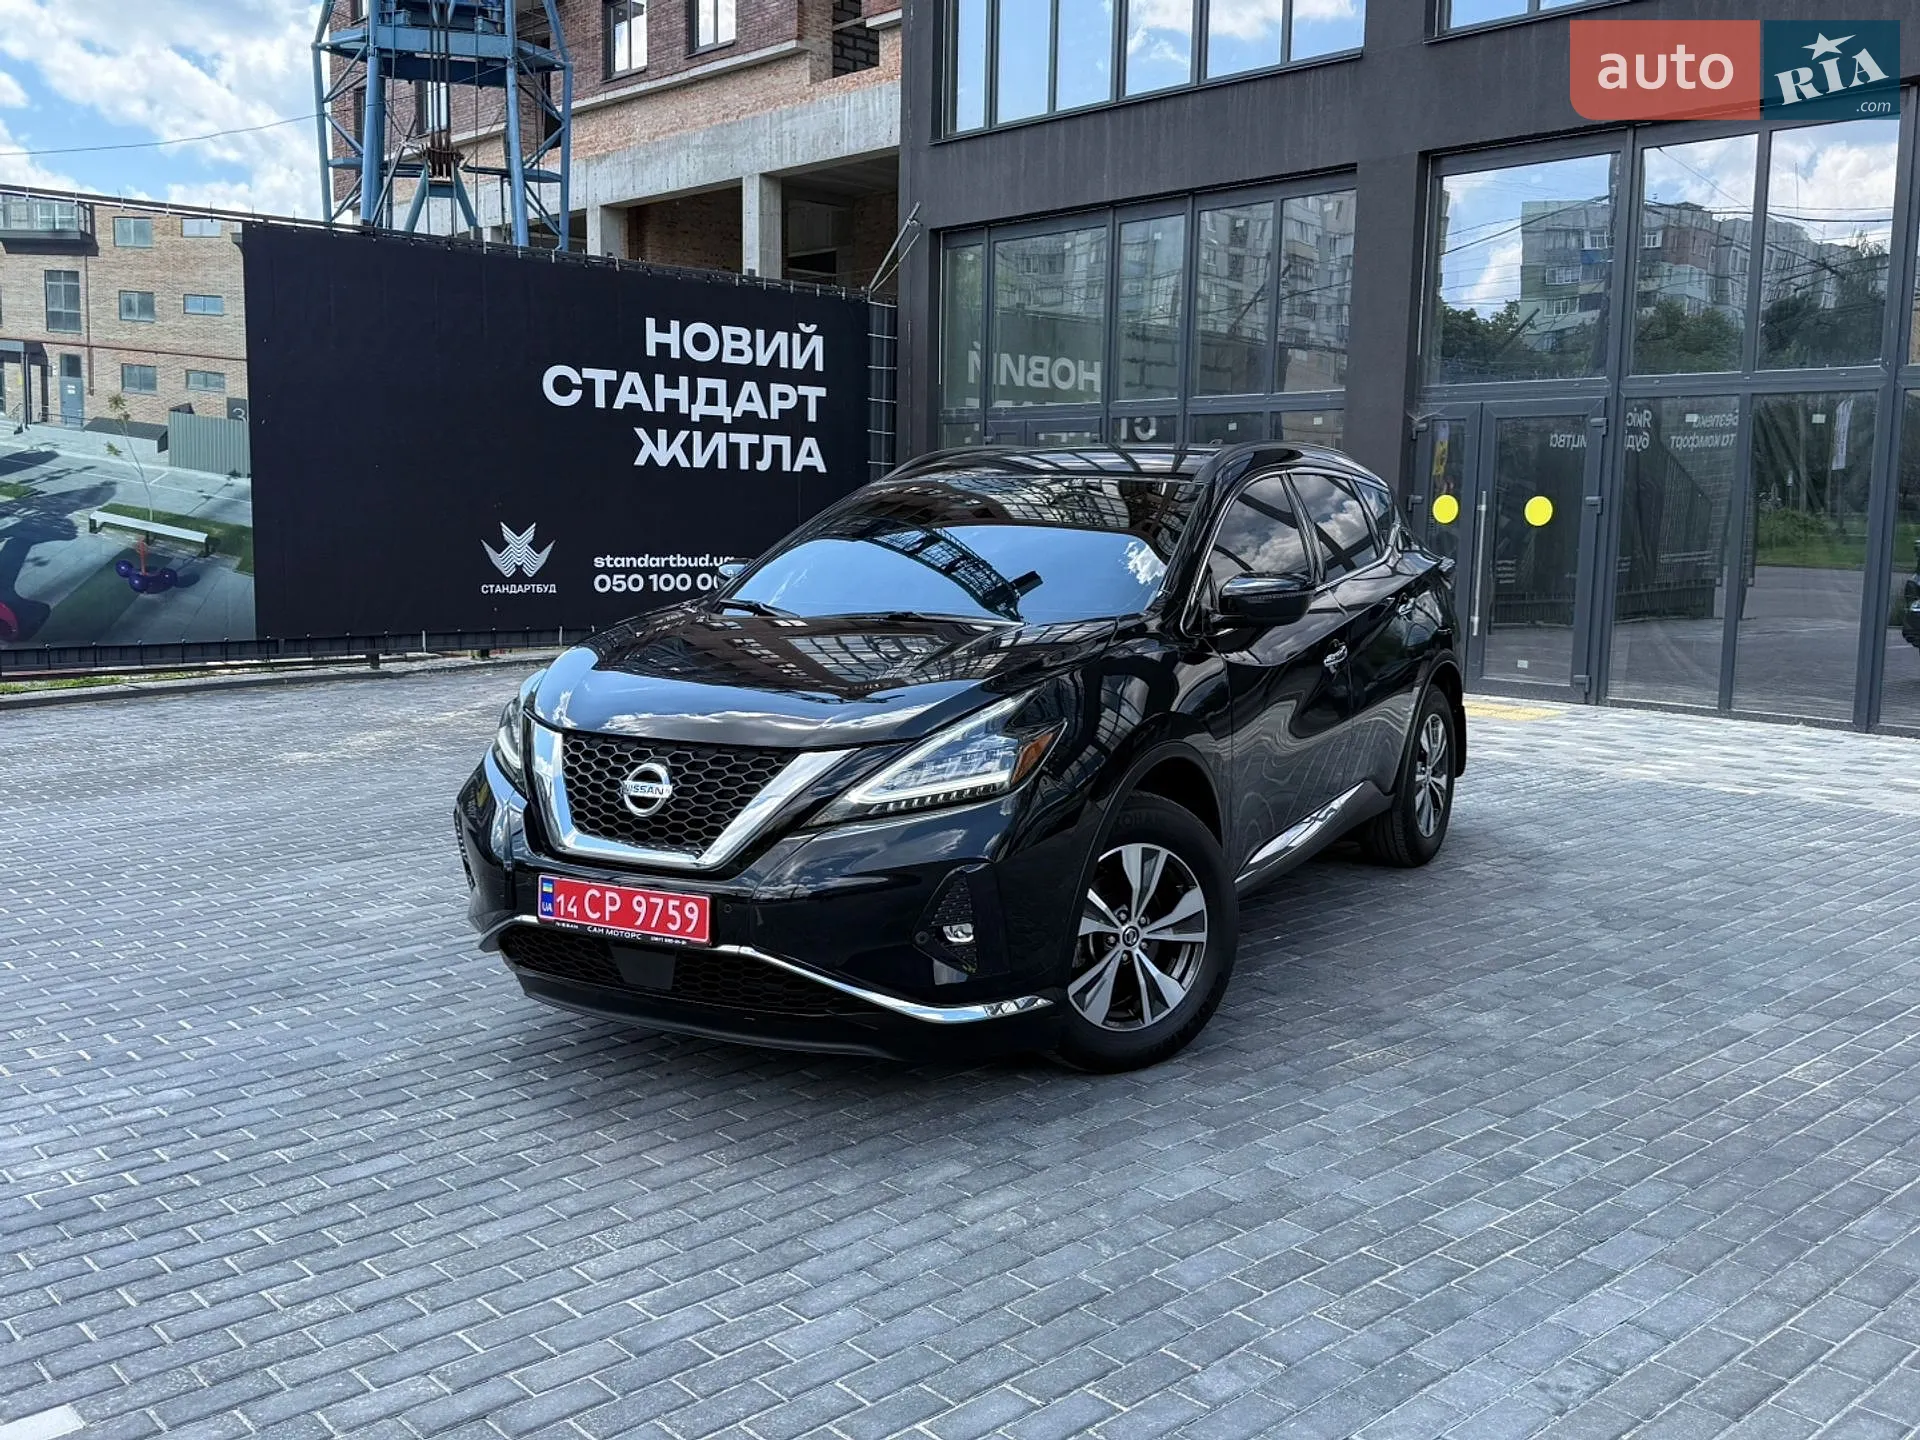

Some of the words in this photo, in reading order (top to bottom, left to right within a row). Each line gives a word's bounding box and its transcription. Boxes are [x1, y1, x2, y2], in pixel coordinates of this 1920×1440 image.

[645, 317, 824, 372] НОВИЙ
[542, 365, 827, 423] СТАНДАРТ
[633, 428, 827, 473] ЖИТЛА
[481, 583, 557, 595] СТАНДАРТБУД
[593, 573, 645, 593] 050
[648, 573, 692, 592] 100
[621, 782, 665, 796] NISSAN
[541, 901, 553, 913] UA
[632, 895, 699, 933] 9759
